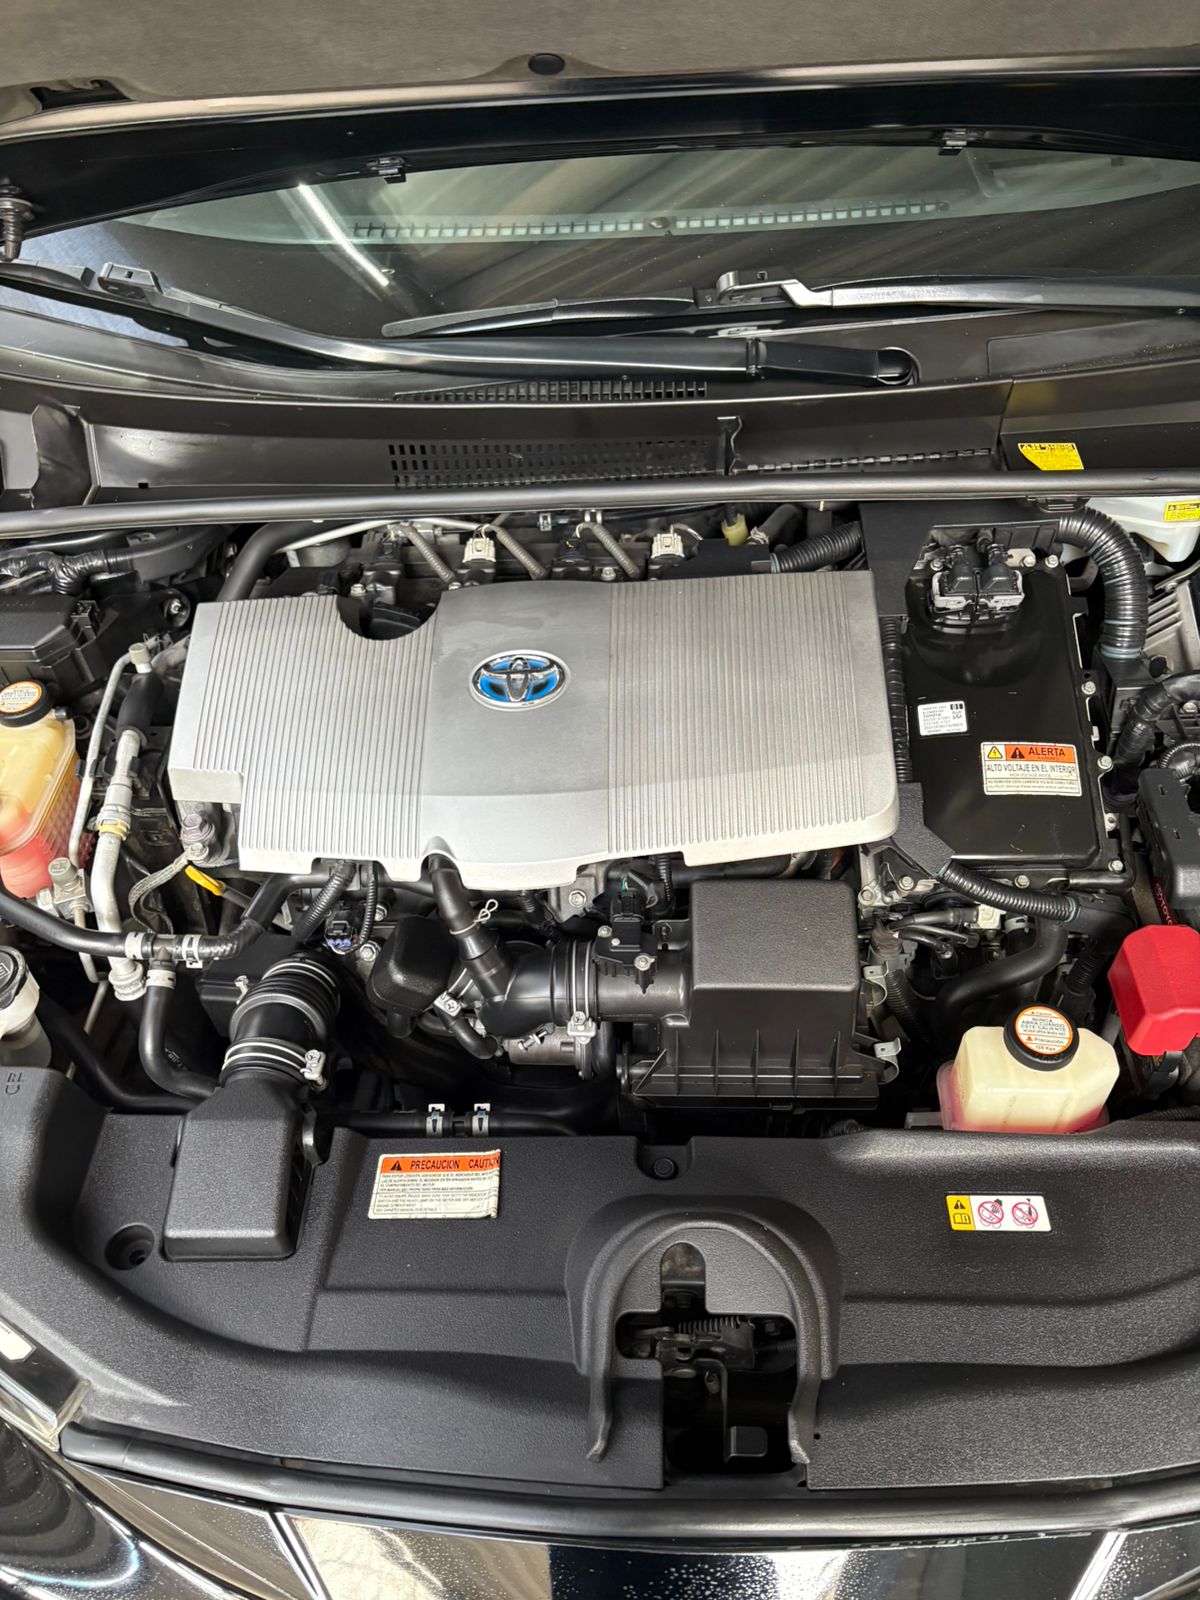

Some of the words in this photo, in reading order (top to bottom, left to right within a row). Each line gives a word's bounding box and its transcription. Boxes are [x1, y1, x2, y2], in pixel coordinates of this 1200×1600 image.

[1028, 746, 1066, 757] ALERTA
[986, 764, 1003, 772] ALTO
[1003, 764, 1030, 772] VOLTAJE
[1031, 764, 1040, 772] EN
[1041, 764, 1049, 773] EL
[1049, 764, 1076, 774] INTERIOR
[410, 1159, 460, 1170] PRECAUCION
